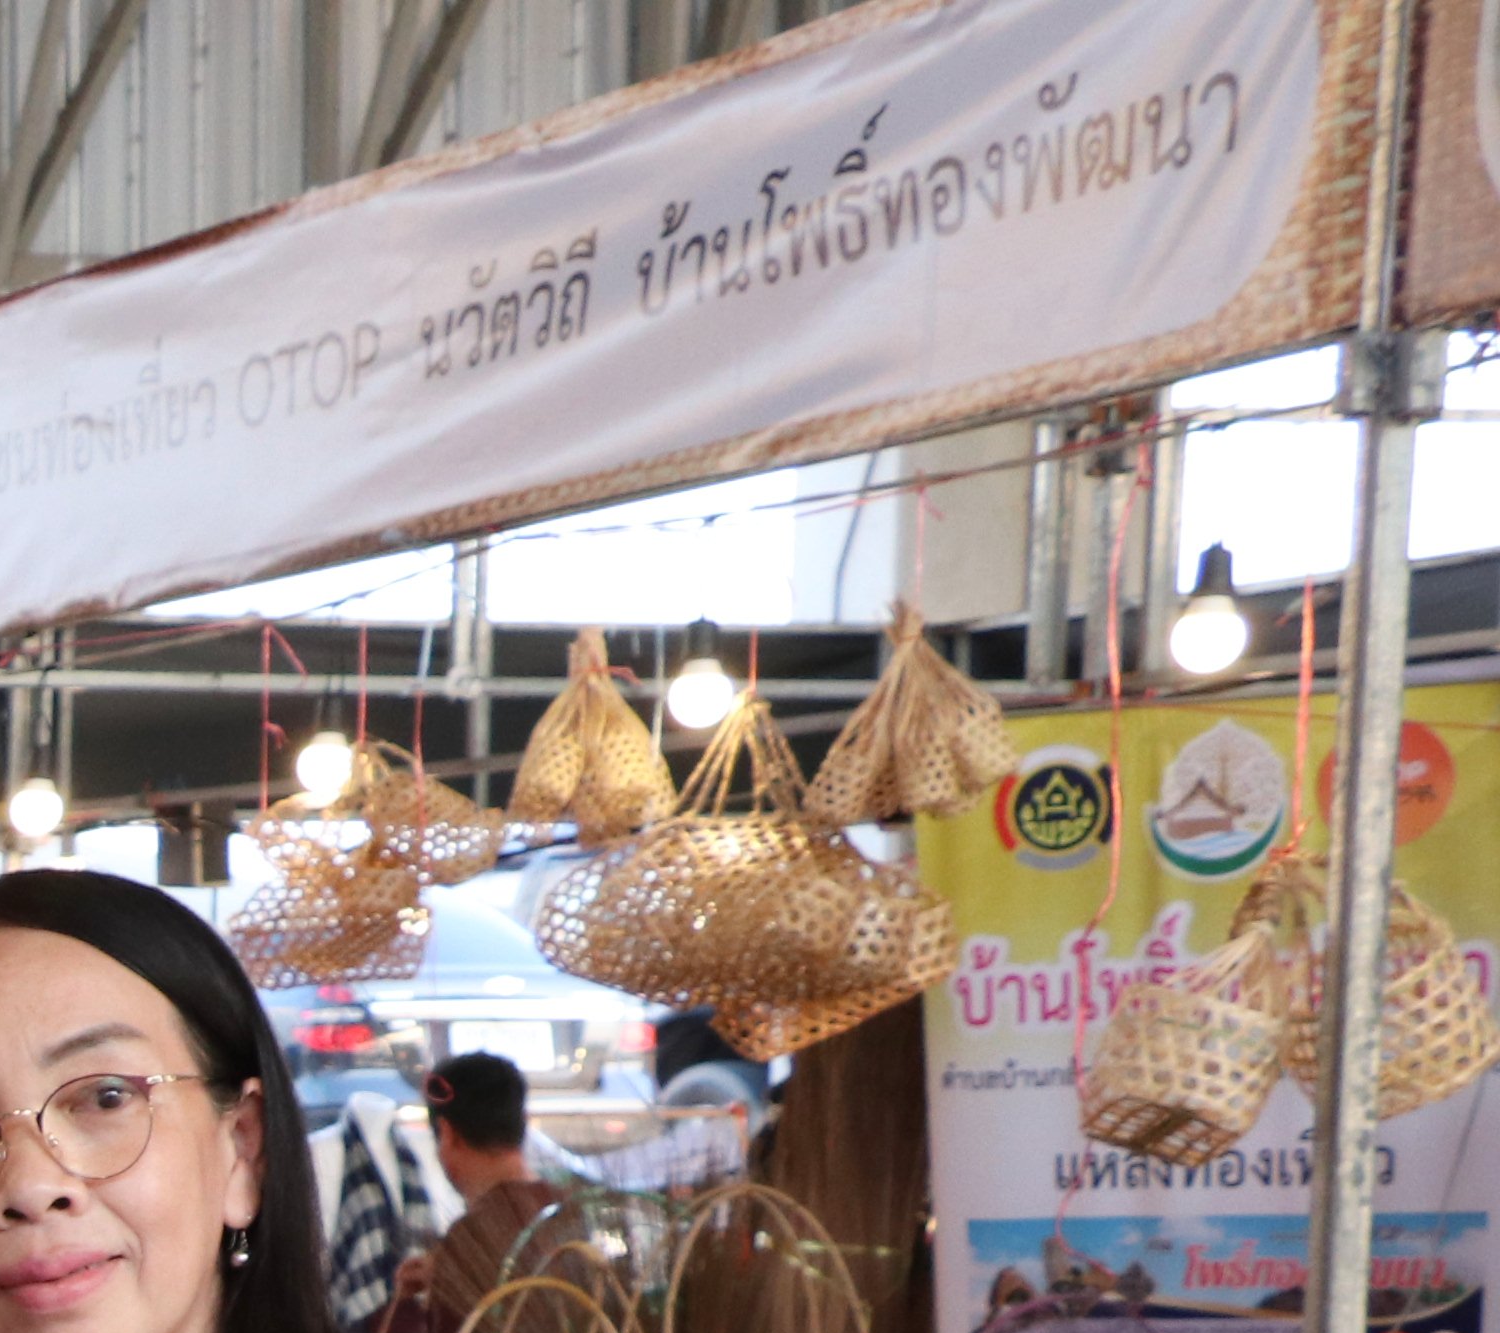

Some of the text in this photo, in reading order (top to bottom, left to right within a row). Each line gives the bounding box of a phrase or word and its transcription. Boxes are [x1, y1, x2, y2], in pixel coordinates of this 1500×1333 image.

[238, 325, 382, 430] OTOP
[421, 231, 600, 377] นวัตวิถี
[636, 69, 1243, 316] บ้านโพธิ์ทองพัฒนา
